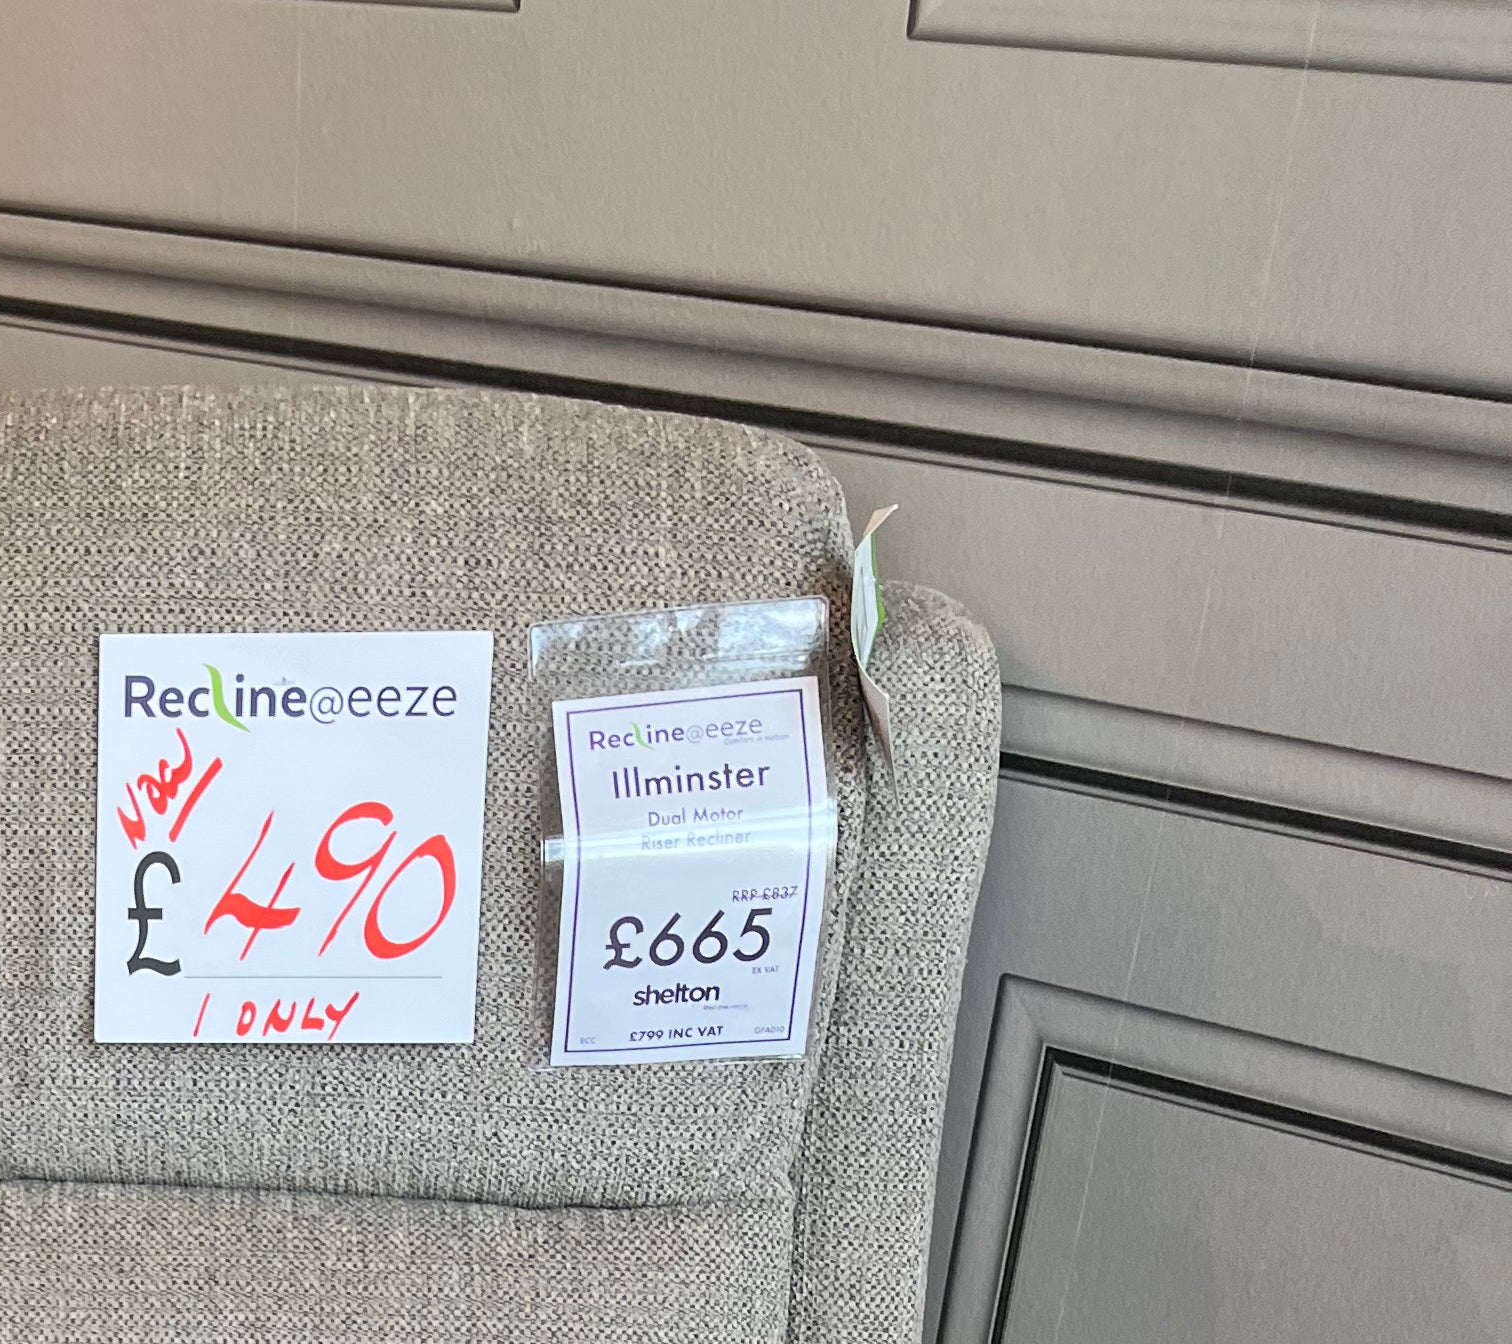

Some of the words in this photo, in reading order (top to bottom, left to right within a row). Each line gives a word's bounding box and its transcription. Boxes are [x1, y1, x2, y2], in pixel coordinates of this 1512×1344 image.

[612, 763, 771, 799] Illminster
[648, 807, 686, 827] Dual
[693, 807, 744, 824] Motor
[641, 834, 680, 851] Riser
[686, 829, 751, 848] Recliner
[732, 888, 758, 902] RRP
[603, 907, 773, 970] £665
[633, 983, 720, 1006] shelton
[236, 992, 360, 1041] ONLY
[629, 1030, 664, 1042] £799
[668, 1027, 693, 1040] INC
[697, 1025, 724, 1037] VAT
